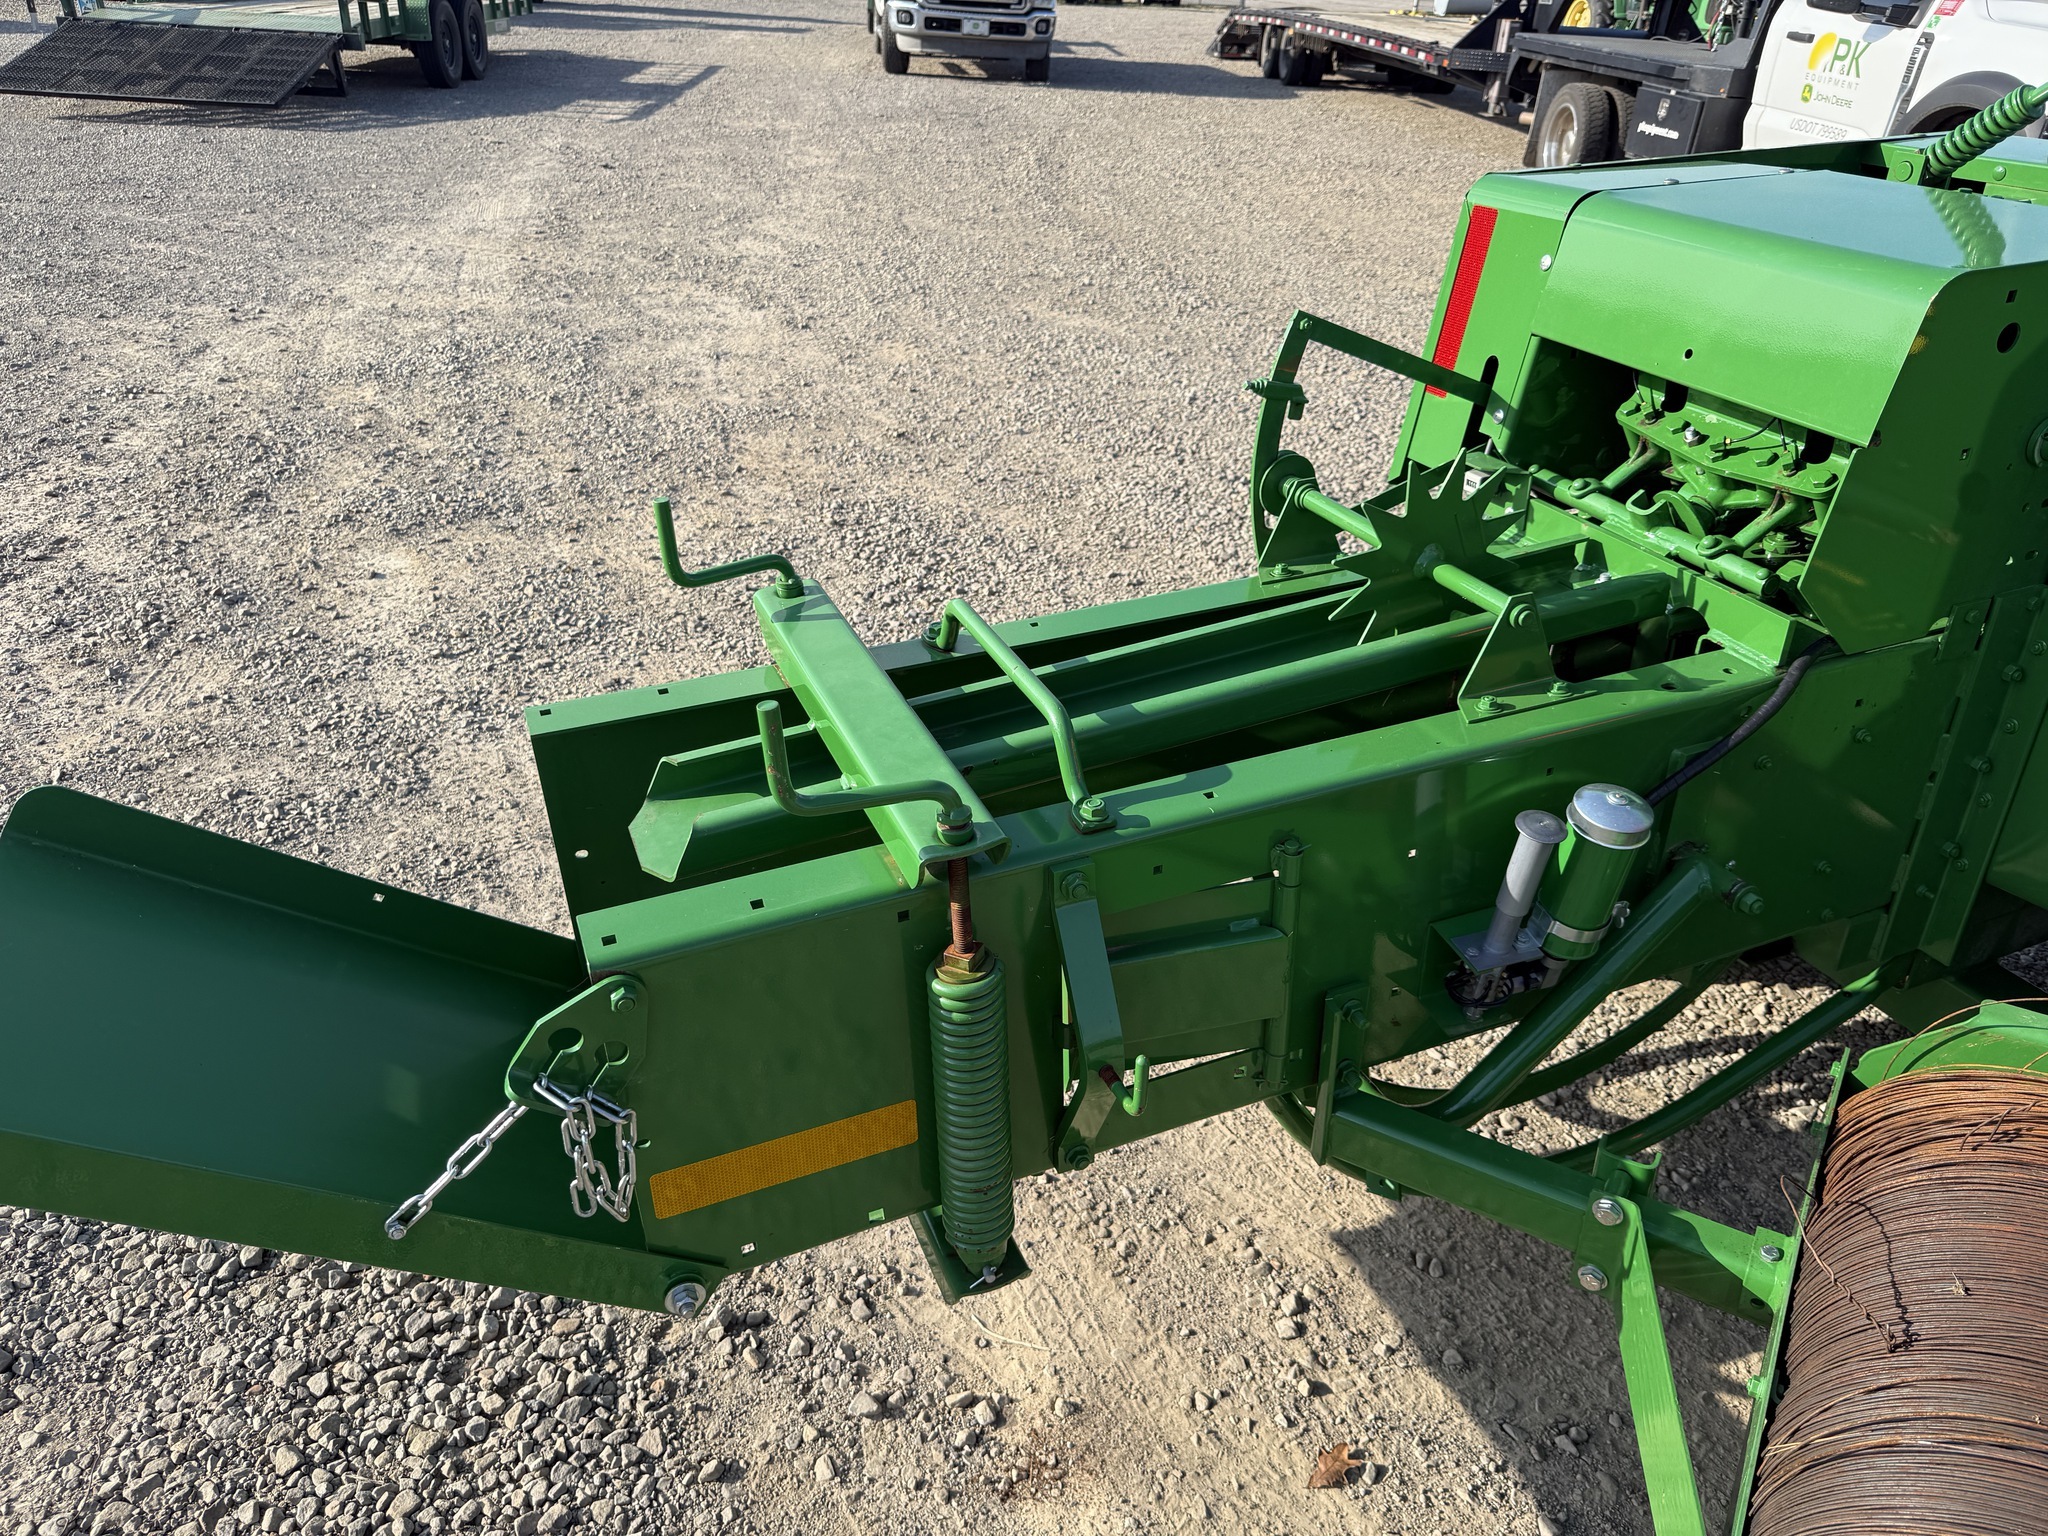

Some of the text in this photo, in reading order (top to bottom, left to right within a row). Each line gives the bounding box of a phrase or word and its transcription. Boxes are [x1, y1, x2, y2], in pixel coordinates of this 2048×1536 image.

[1805, 72, 1859, 91] EQUIPMENT
[1813, 91, 1853, 109] JOHN DEERE
[1790, 118, 1819, 134] USDOT
